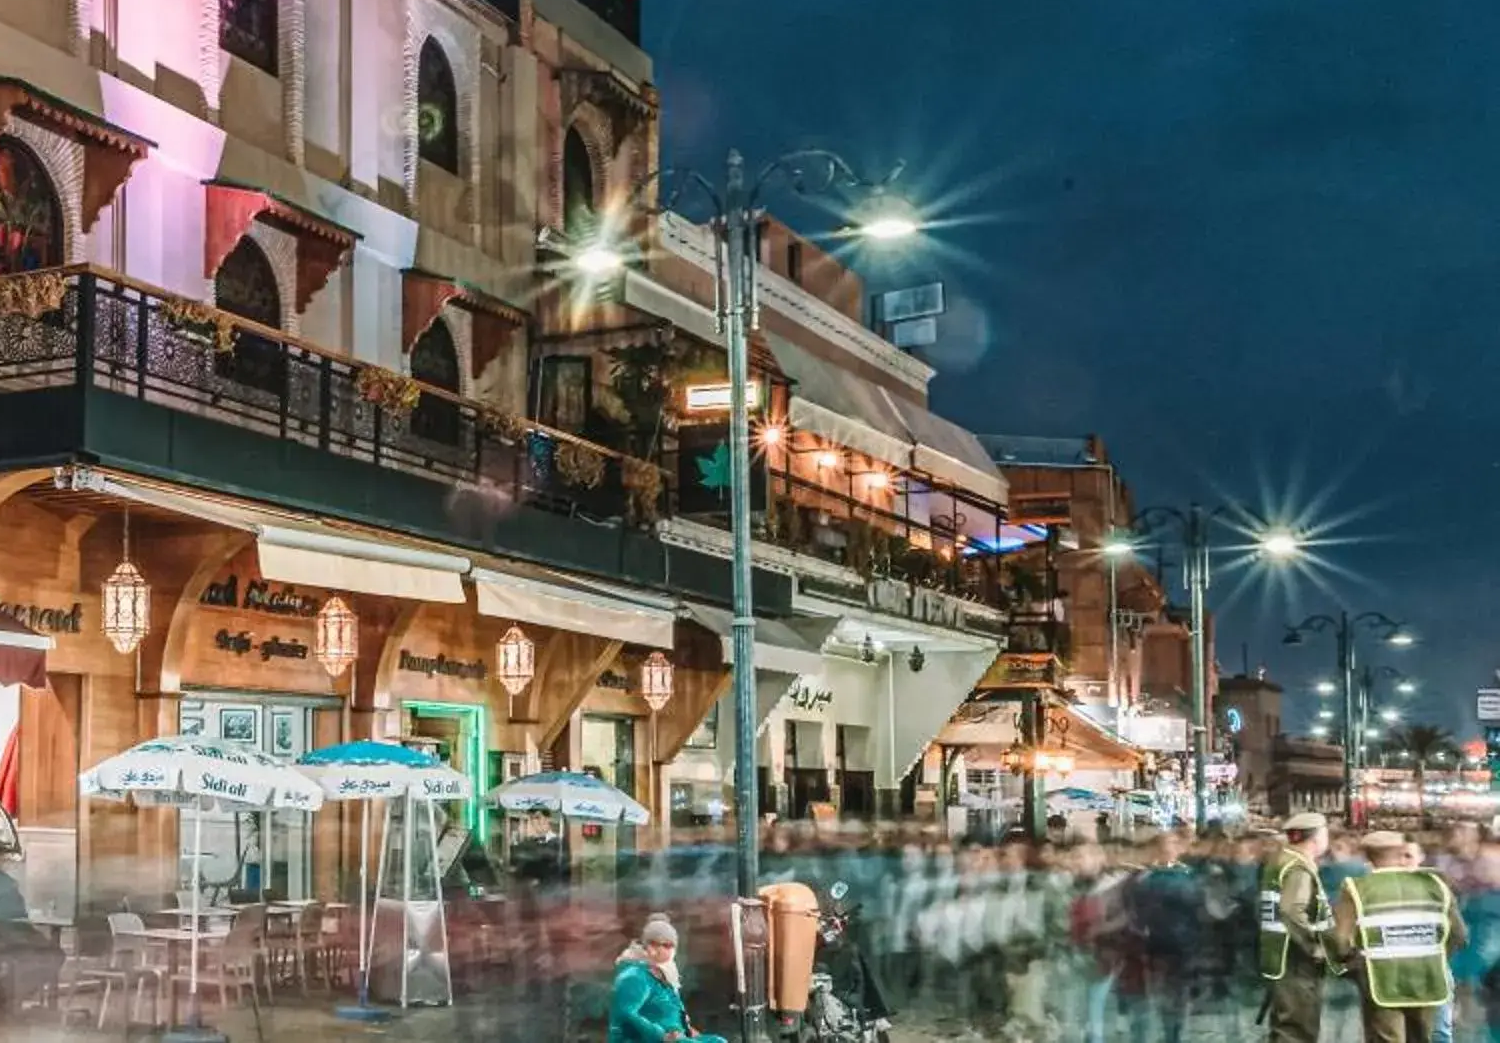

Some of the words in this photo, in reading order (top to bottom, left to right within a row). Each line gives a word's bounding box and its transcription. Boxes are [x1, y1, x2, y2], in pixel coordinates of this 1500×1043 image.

[201, 772, 228, 793] Sidi
[229, 782, 249, 798] ali
[423, 779, 444, 796] Sidi
